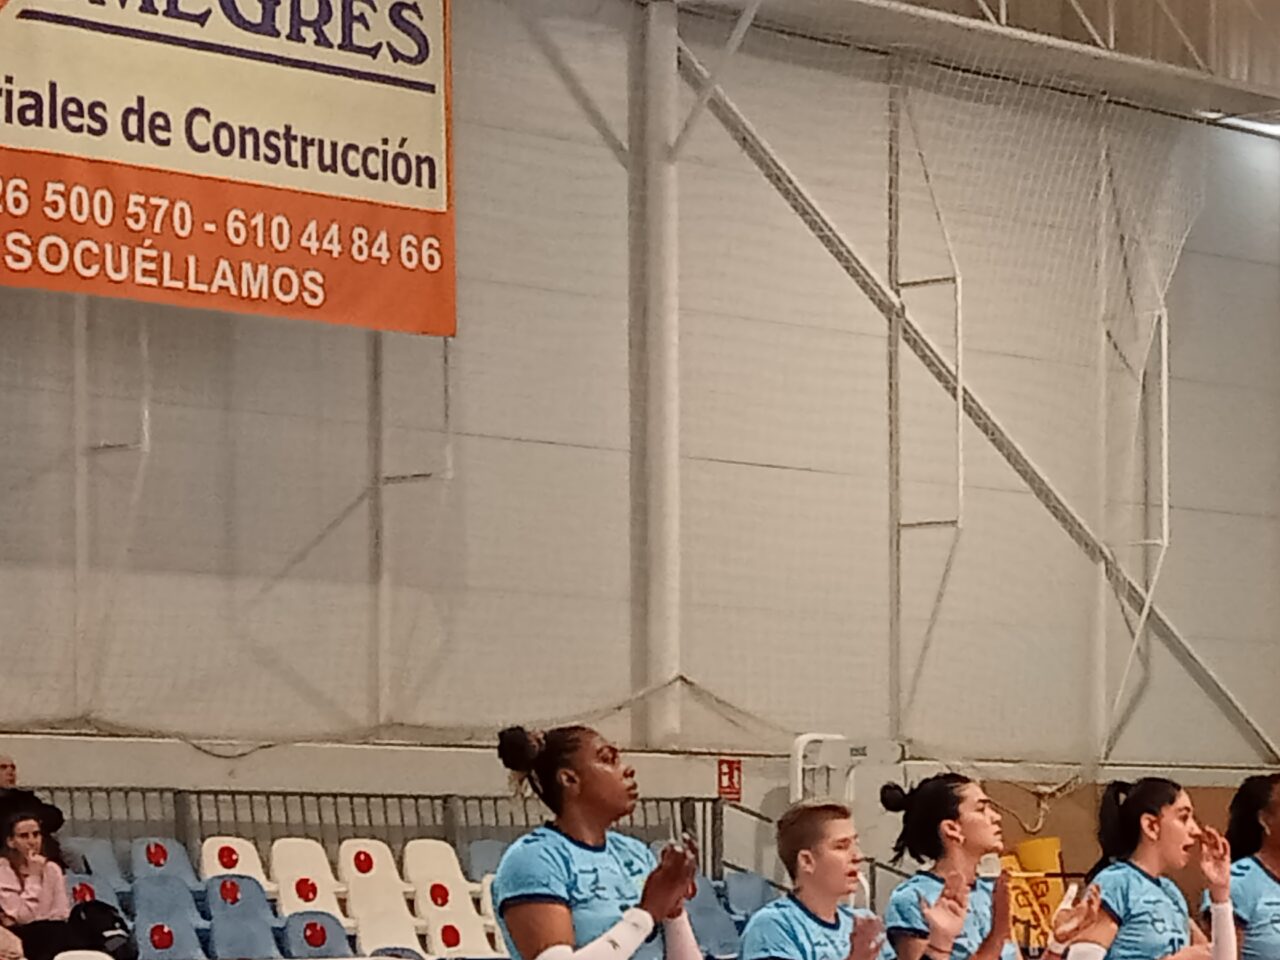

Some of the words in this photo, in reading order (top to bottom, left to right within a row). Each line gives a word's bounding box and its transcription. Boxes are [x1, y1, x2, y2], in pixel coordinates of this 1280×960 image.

[0, 75, 109, 137] iales
[121, 95, 172, 147] de
[184, 107, 437, 190] Construcción
[0, 178, 30, 217] 6
[43, 182, 114, 227] 500
[125, 194, 194, 239] 570
[226, 208, 291, 252] 610
[300, 218, 342, 259] 44
[350, 225, 391, 265] 84
[399, 234, 442, 272] 66
[4, 231, 325, 307] SOCUÉLLAMOS
